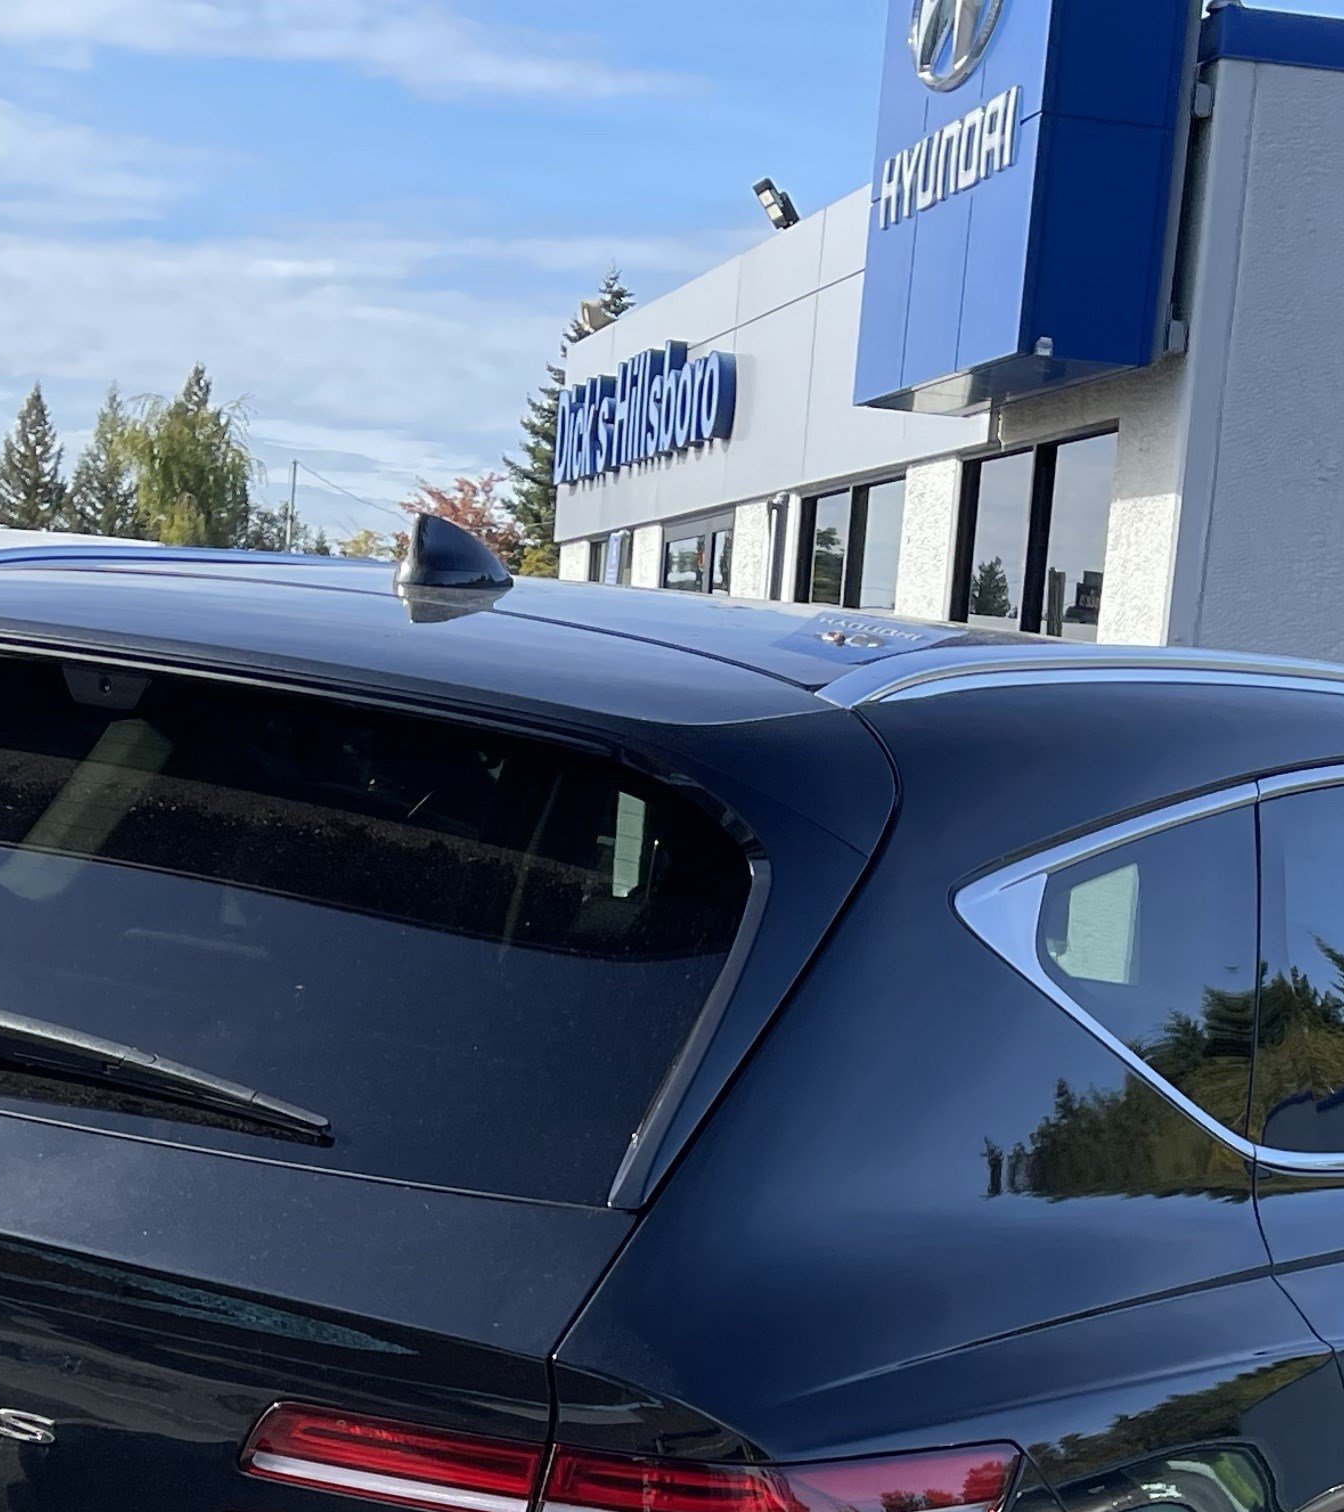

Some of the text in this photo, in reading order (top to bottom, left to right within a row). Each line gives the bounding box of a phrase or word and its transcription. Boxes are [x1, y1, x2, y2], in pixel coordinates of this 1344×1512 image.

[880, 85, 1020, 230] HYUNDAI
[554, 340, 730, 485] Dick's Hillsboro
